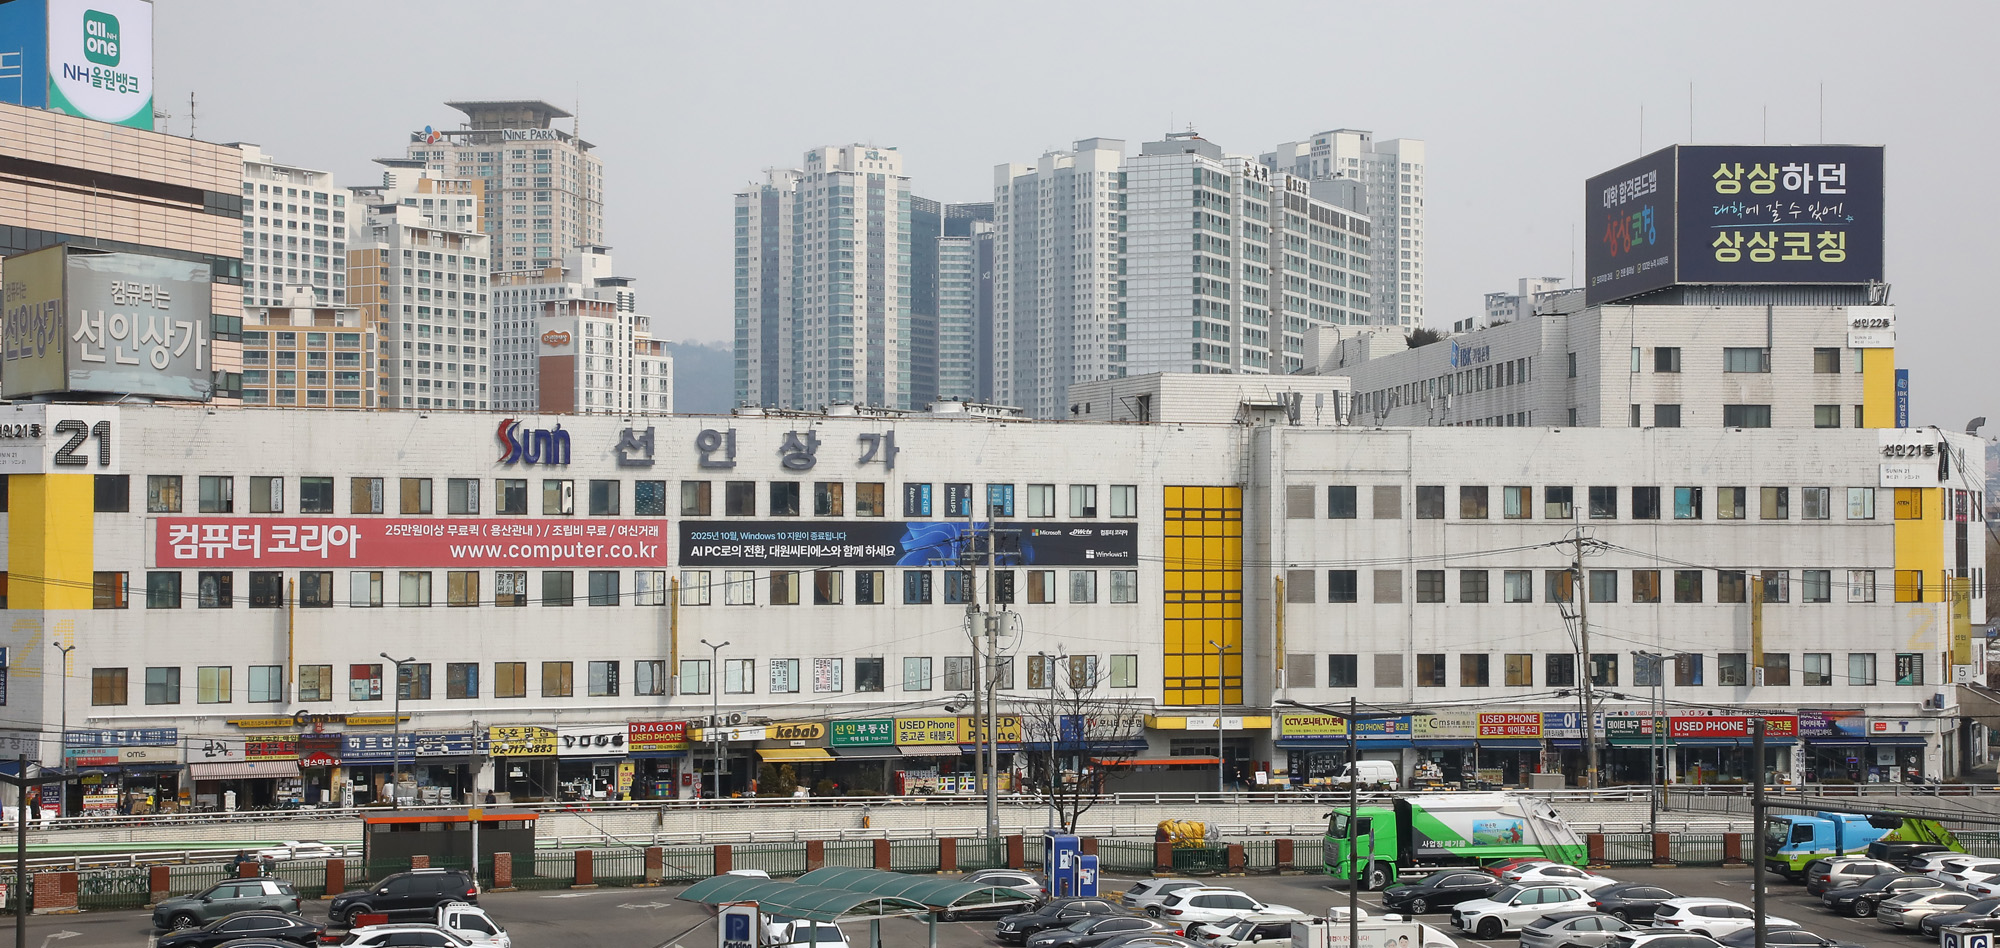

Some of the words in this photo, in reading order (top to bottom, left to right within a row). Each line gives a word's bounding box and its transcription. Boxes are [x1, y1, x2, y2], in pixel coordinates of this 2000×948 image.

[86, 20, 106, 38] all
[107, 32, 117, 40] NH
[86, 37, 118, 57] one
[530, 130, 556, 143] PARK
[1712, 162, 1847, 195] 상상하던
[1603, 185, 1618, 209] 대학
[1619, 169, 1657, 205] 합격로드맵
[1712, 201, 1759, 219] 대학에
[1766, 200, 1783, 223] 갈
[1788, 201, 1802, 219] 수
[1807, 201, 1844, 222] 있어!
[1603, 203, 1656, 257] 상상코칭
[1711, 230, 1847, 263] 상상코칭
[6, 281, 27, 302] 컴퓨터는
[111, 280, 171, 309] 컴퓨터는
[1853, 318, 1890, 328] 선인22동
[5, 298, 63, 361] 선인상가
[72, 309, 207, 371] 선인상가
[55, 419, 111, 466] 21
[1883, 444, 1935, 457] 선인21동
[385, 523, 445, 537] 25만원이상
[447, 523, 479, 537] 무료퀵
[490, 523, 534, 537] 용산관내
[552, 523, 584, 537] 조립비
[586, 524, 607, 537] 무료
[617, 523, 659, 537] 여신거래
[168, 524, 261, 559] 컴퓨터
[267, 524, 362, 559] 코리아
[691, 532, 719, 541] 2025년
[720, 532, 739, 542] 10월,
[739, 532, 776, 541] Windows
[777, 532, 786, 540] 10
[787, 532, 809, 541] 지원이
[810, 532, 847, 541] 종료됩니다
[450, 541, 658, 560] www.computer.co.kr
[691, 546, 703, 557] AI
[705, 545, 741, 558] PC로의
[743, 545, 768, 559] 전환,
[769, 545, 842, 558] 대원씨티에스와
[843, 545, 864, 558] 함께
[865, 545, 896, 558] 하세요
[1959, 666, 1966, 677] 5
[899, 720, 925, 729] USED
[927, 720, 955, 729] Phone
[1086, 718, 1097, 727] TV
[1212, 718, 1220, 728] 4
[1481, 714, 1505, 723] USED
[1507, 714, 1538, 723] PHONE
[1607, 720, 1626, 729] 데이터
[1626, 720, 1640, 729] 복구
[631, 724, 682, 733] DRAGON
[775, 724, 819, 739] kebab
[834, 723, 889, 735] 선인부동산
[1365, 723, 1385, 731] PHONE
[1481, 725, 1505, 735] 중고폰
[1507, 725, 1538, 735] 아이폰수리
[1673, 721, 1703, 731] USED
[1705, 721, 1744, 731] PHONE
[1766, 720, 1792, 731] 중고폰
[631, 732, 653, 742] USED
[654, 732, 683, 742] PHONE
[731, 728, 740, 740] 3
[899, 731, 925, 742] 중고폰
[929, 731, 955, 742] 태블릿
[968, 731, 1015, 741] Phne
[247, 742, 298, 755] 컴퓨터
[348, 736, 410, 749] 하드전자
[126, 750, 147, 758] oms
[303, 758, 333, 767] 컴스마트
[1421, 840, 1444, 848] 사업장
[1444, 839, 1466, 848] 폐기물
[732, 917, 744, 941] P
